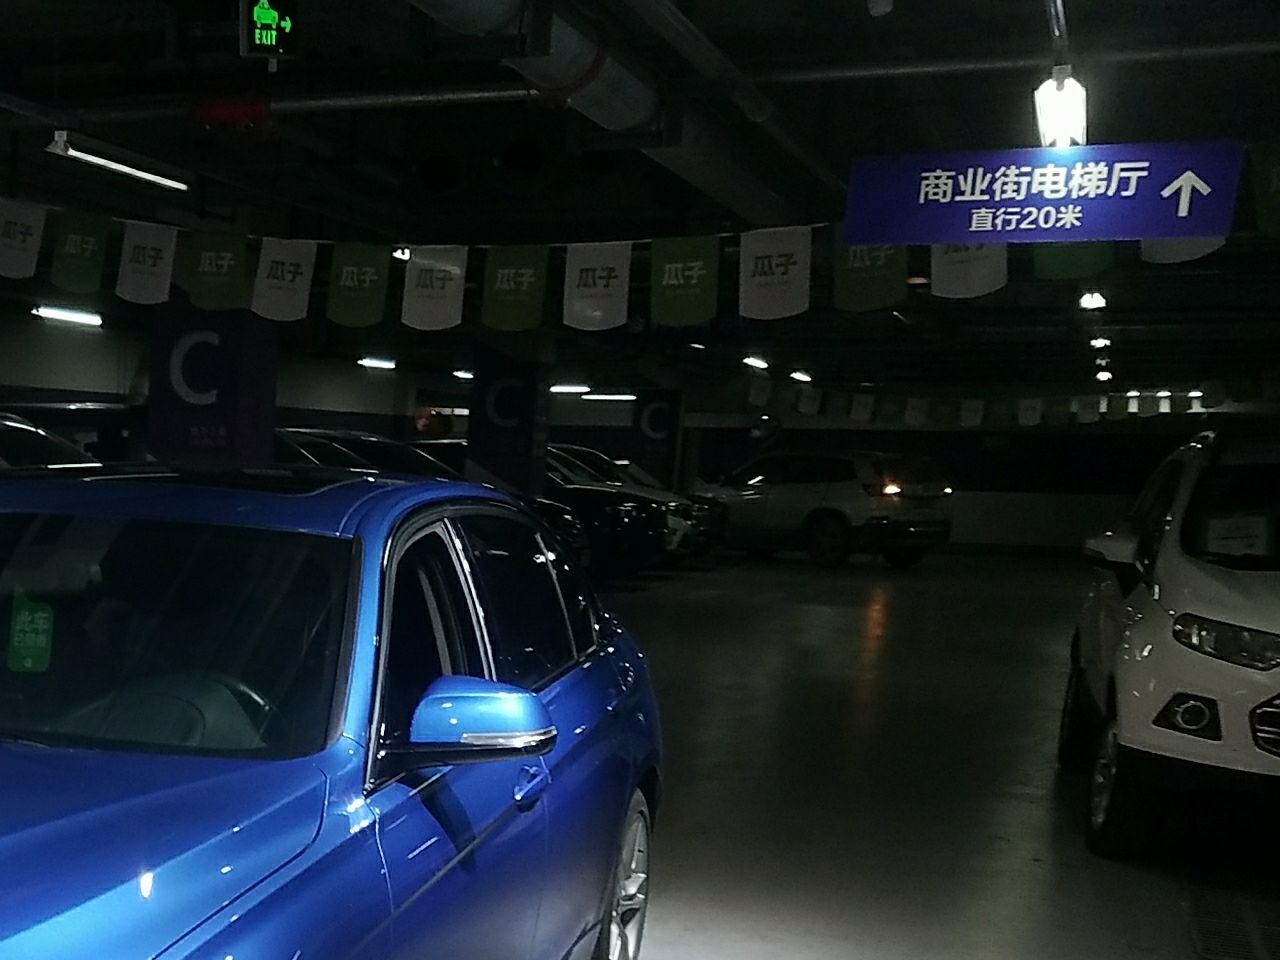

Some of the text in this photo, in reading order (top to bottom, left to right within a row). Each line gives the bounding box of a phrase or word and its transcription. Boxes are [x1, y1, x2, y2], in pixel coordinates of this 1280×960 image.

[255, 29, 277, 45] EXIT
[919, 161, 1150, 203] 商业街电梯厅
[968, 206, 1083, 231] 直行20米
[130, 245, 164, 268] 瓜子
[198, 252, 235, 273] 瓜子
[752, 253, 798, 278] 瓜子
[267, 260, 303, 283] 瓜子
[340, 266, 378, 288] 瓜子
[415, 269, 454, 290] 瓜子
[496, 268, 536, 291] 瓜子
[577, 266, 619, 290] 瓜子
[662, 261, 707, 286] 瓜子
[169, 329, 219, 405] C
[486, 378, 524, 428] C
[640, 401, 671, 440] C
